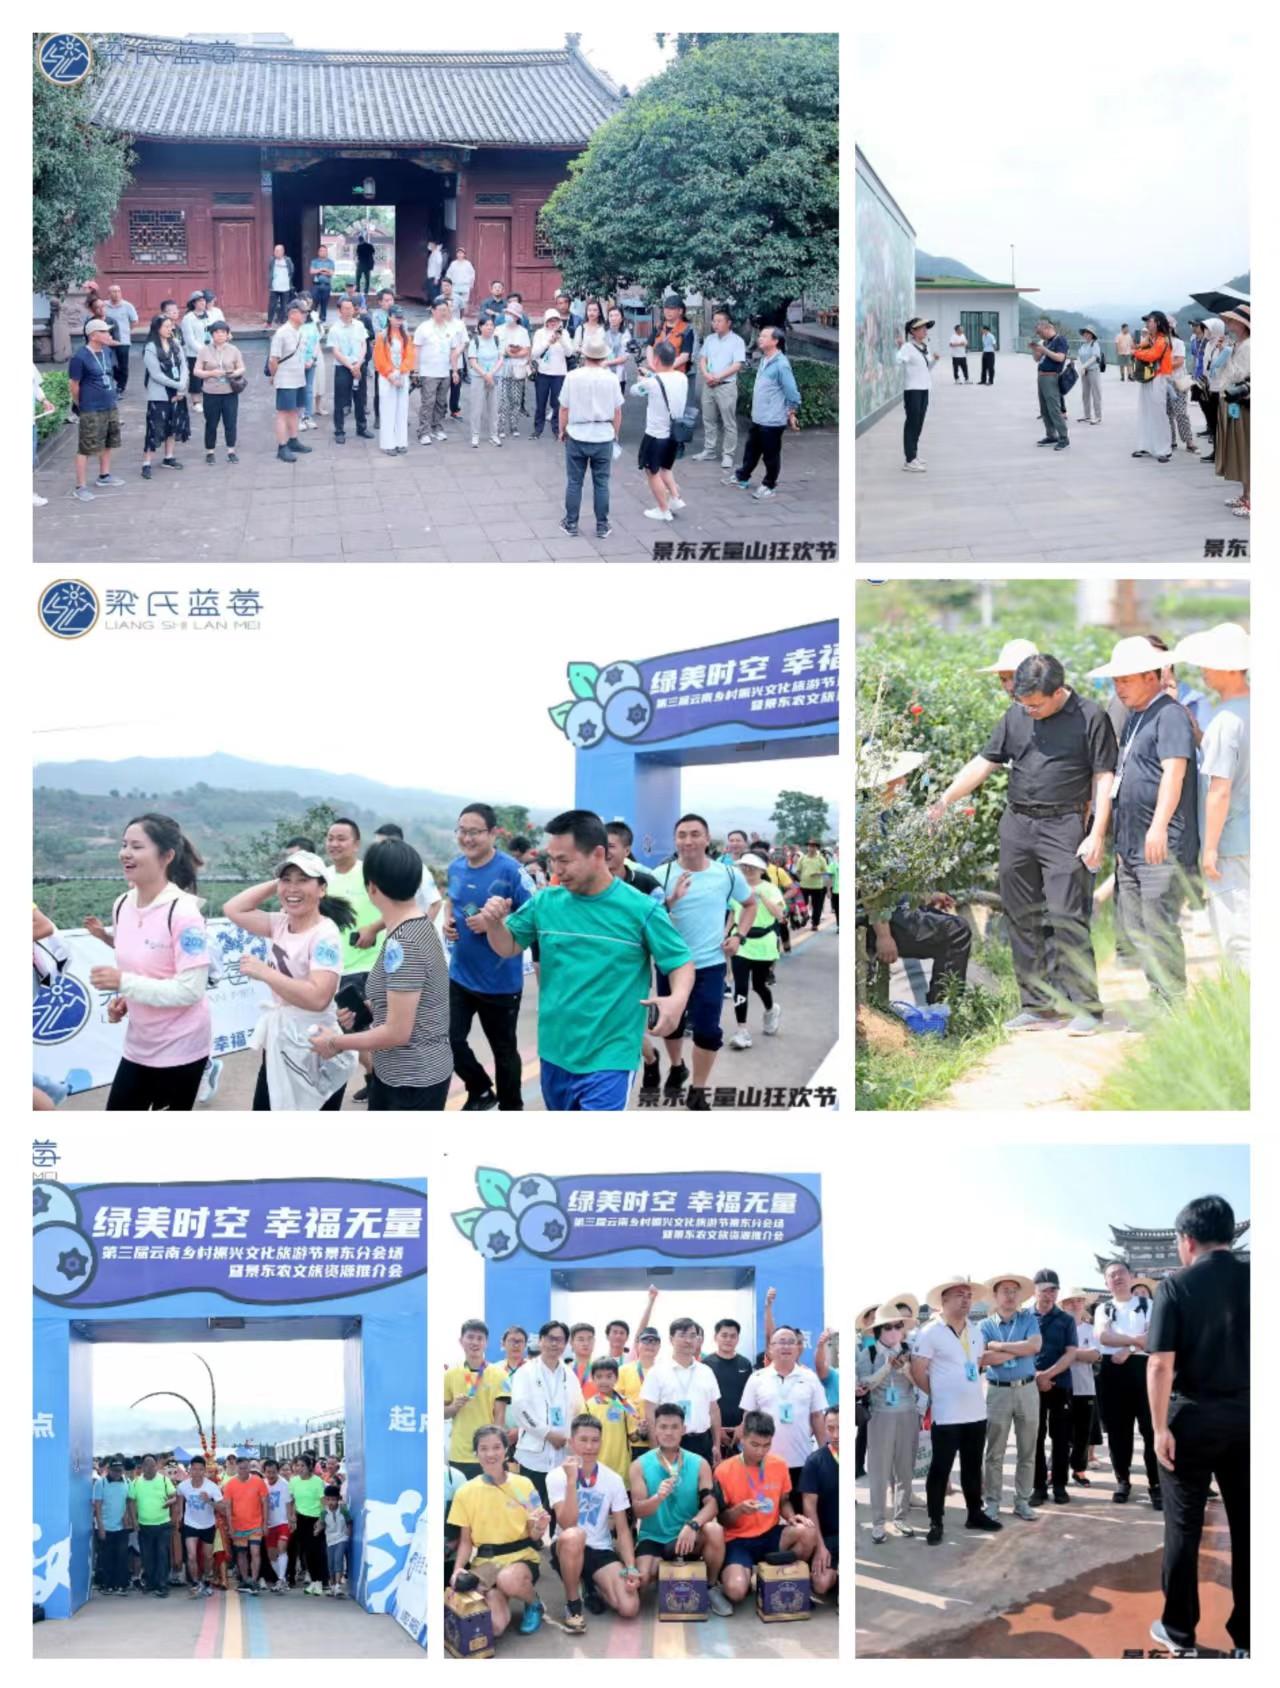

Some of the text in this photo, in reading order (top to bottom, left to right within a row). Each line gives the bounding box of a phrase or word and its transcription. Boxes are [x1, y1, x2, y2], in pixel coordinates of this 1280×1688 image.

[650, 656, 770, 695] 绿美时空
[656, 676, 839, 709] 第三届云南乡村振兴文化旅游节
[750, 691, 839, 711] 暨景东农文旅
[567, 1190, 798, 1214] 绿美时空 幸福无量
[92, 1206, 423, 1239] 绿美时空 幸福无量
[102, 1246, 404, 1260] 第三届云南乡村振兴文化旅游节景东分会场
